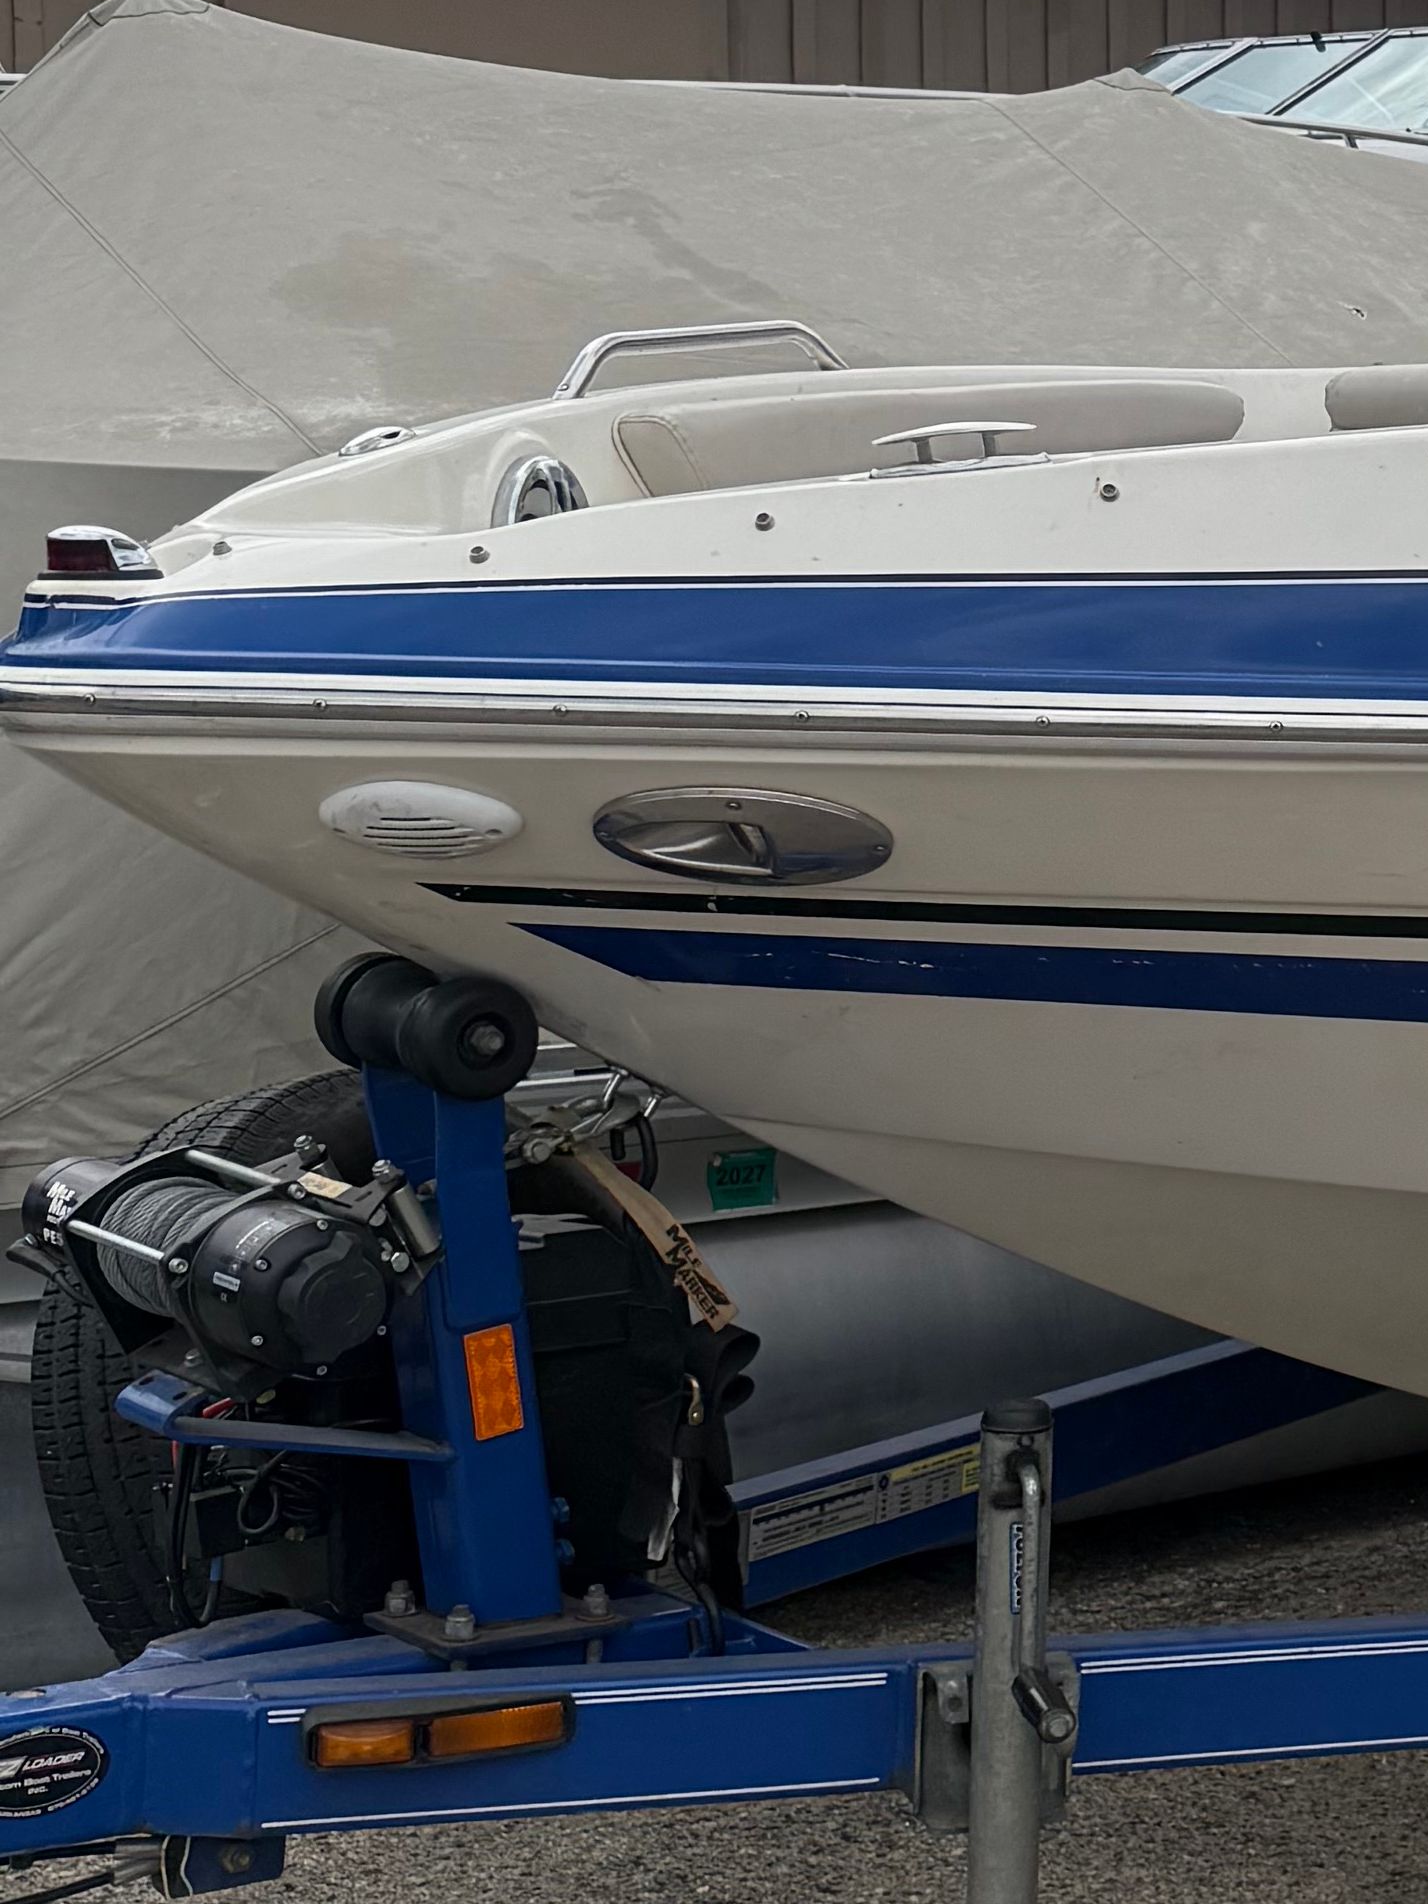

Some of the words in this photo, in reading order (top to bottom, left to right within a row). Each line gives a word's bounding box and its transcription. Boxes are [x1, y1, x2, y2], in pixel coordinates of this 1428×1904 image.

[716, 1164, 767, 1186] 2027
[666, 1243, 720, 1319] MARKER
[22, 1751, 86, 1771] LOADER
